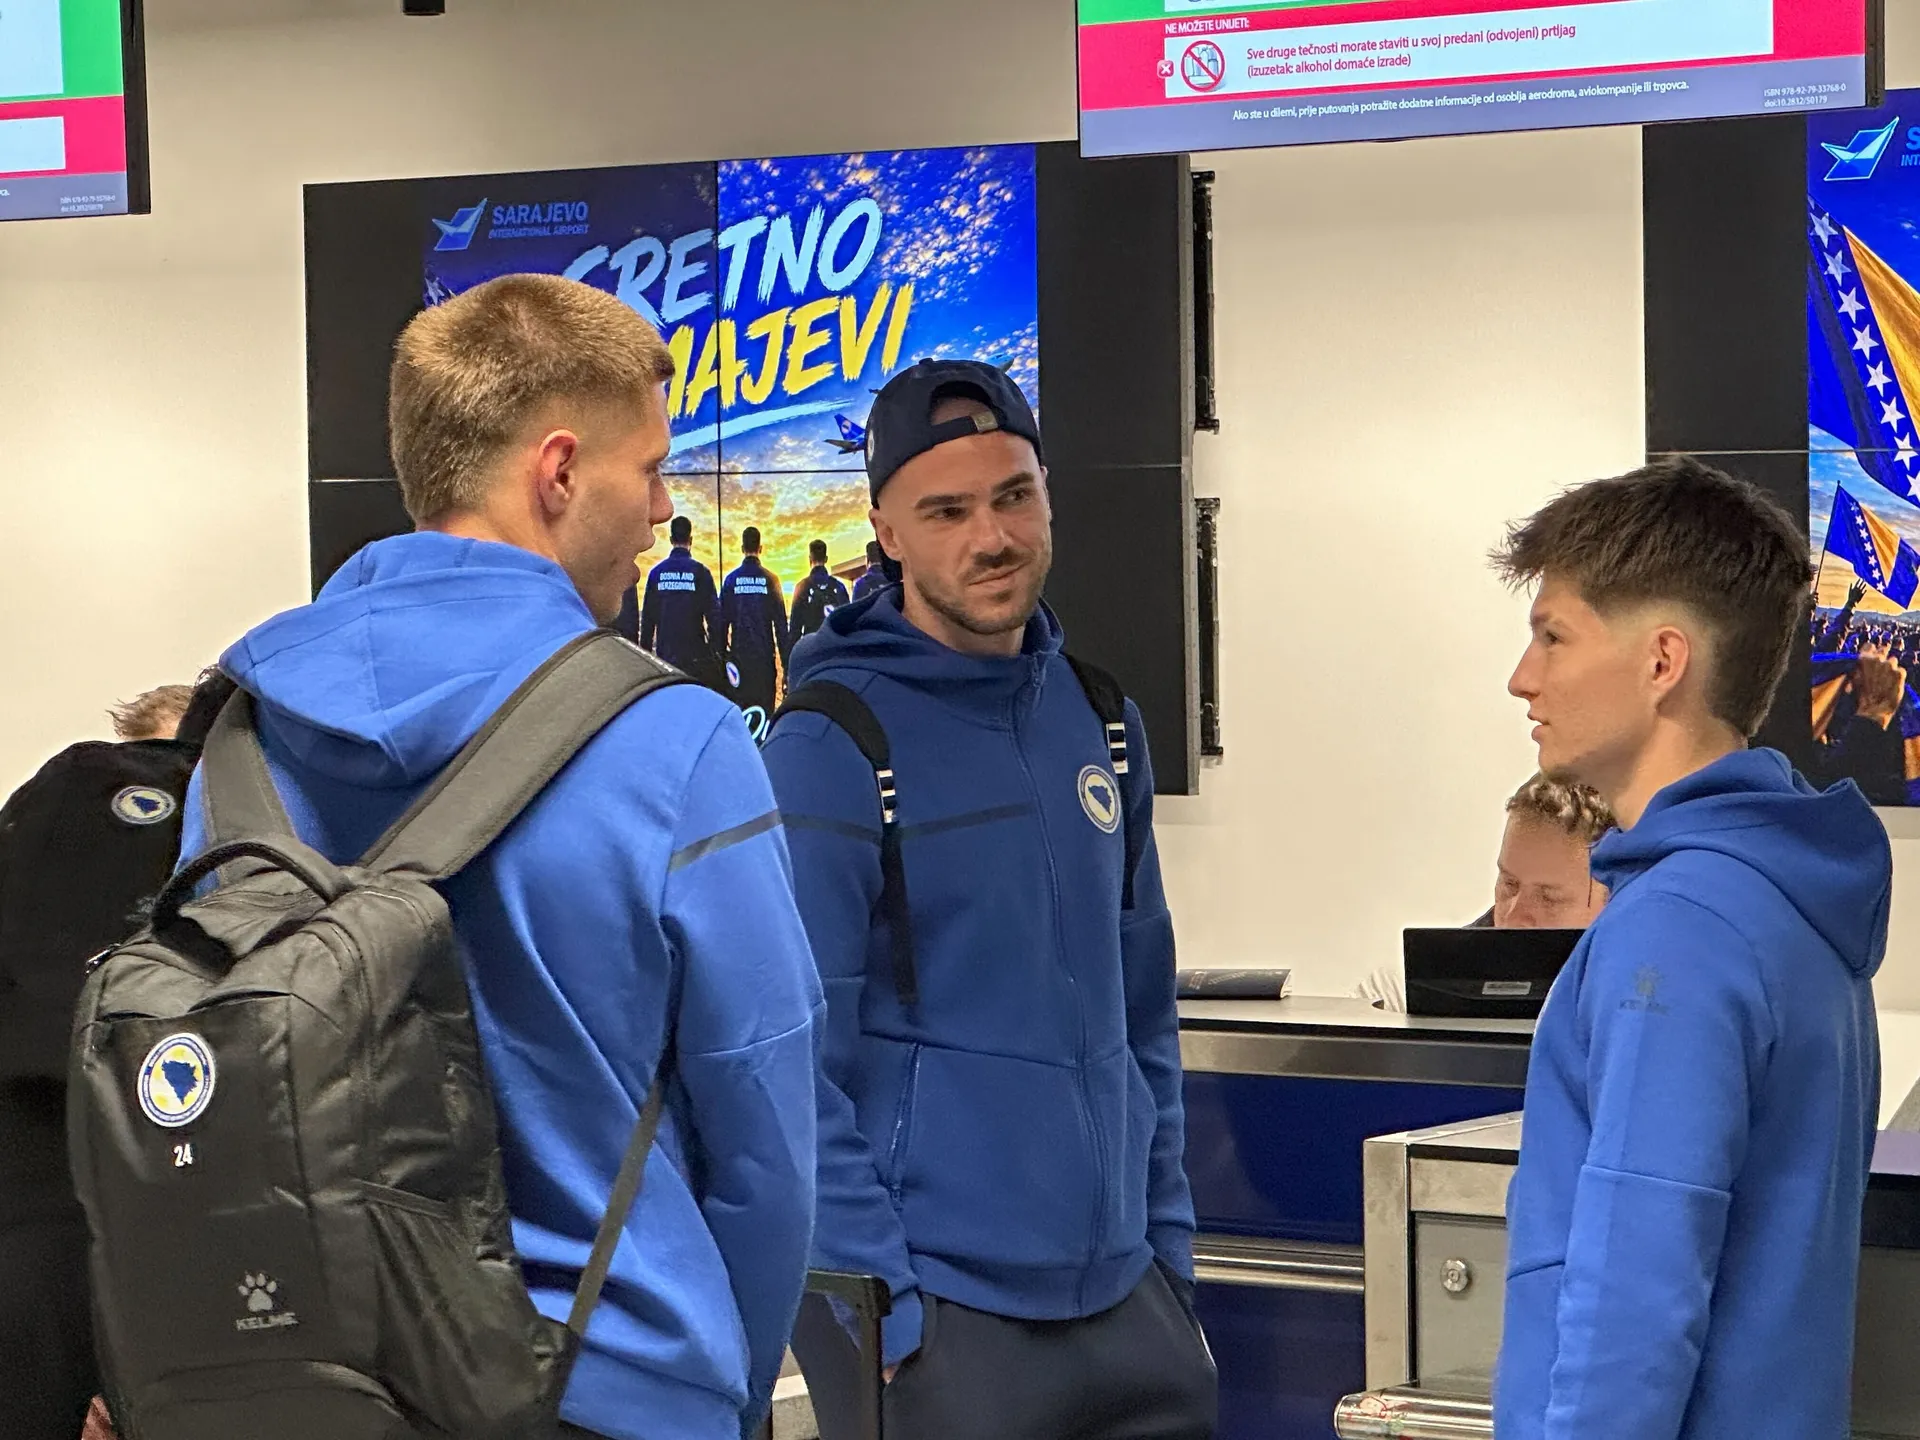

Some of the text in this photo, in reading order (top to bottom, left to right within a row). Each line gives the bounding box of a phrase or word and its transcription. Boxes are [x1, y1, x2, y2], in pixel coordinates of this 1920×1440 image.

[1165, 22, 1177, 34] NE
[1178, 19, 1214, 33] MOŽETE
[1247, 23, 1576, 62] Sve druge tečnosti morate staviti u svoj predani (odvojeni) prtljag
[1247, 54, 1411, 78] (izuzetak: alkohol domaće izrade)
[1233, 110, 1249, 120] Ako
[1250, 110, 1262, 119] ste
[1263, 110, 1269, 118] u
[1271, 106, 1298, 118] dilemi,
[1299, 105, 1317, 118] prije
[1318, 101, 1359, 117] putovanja
[1360, 99, 1397, 113] potražite
[1399, 97, 1433, 109] dodatne
[1435, 93, 1482, 107] informacije
[1483, 92, 1495, 103] od
[1496, 88, 1526, 103] osoblja
[1528, 86, 1577, 99] aerodroma,
[1579, 81, 1643, 97] aviokompanije
[1653, 80, 1689, 94] trgovca.
[1764, 88, 1780, 97] ISBN
[493, 202, 589, 226] SARAJEVO
[489, 224, 590, 239] INTERNATIONAL AIRPORT
[173, 1143, 194, 1168] 24
